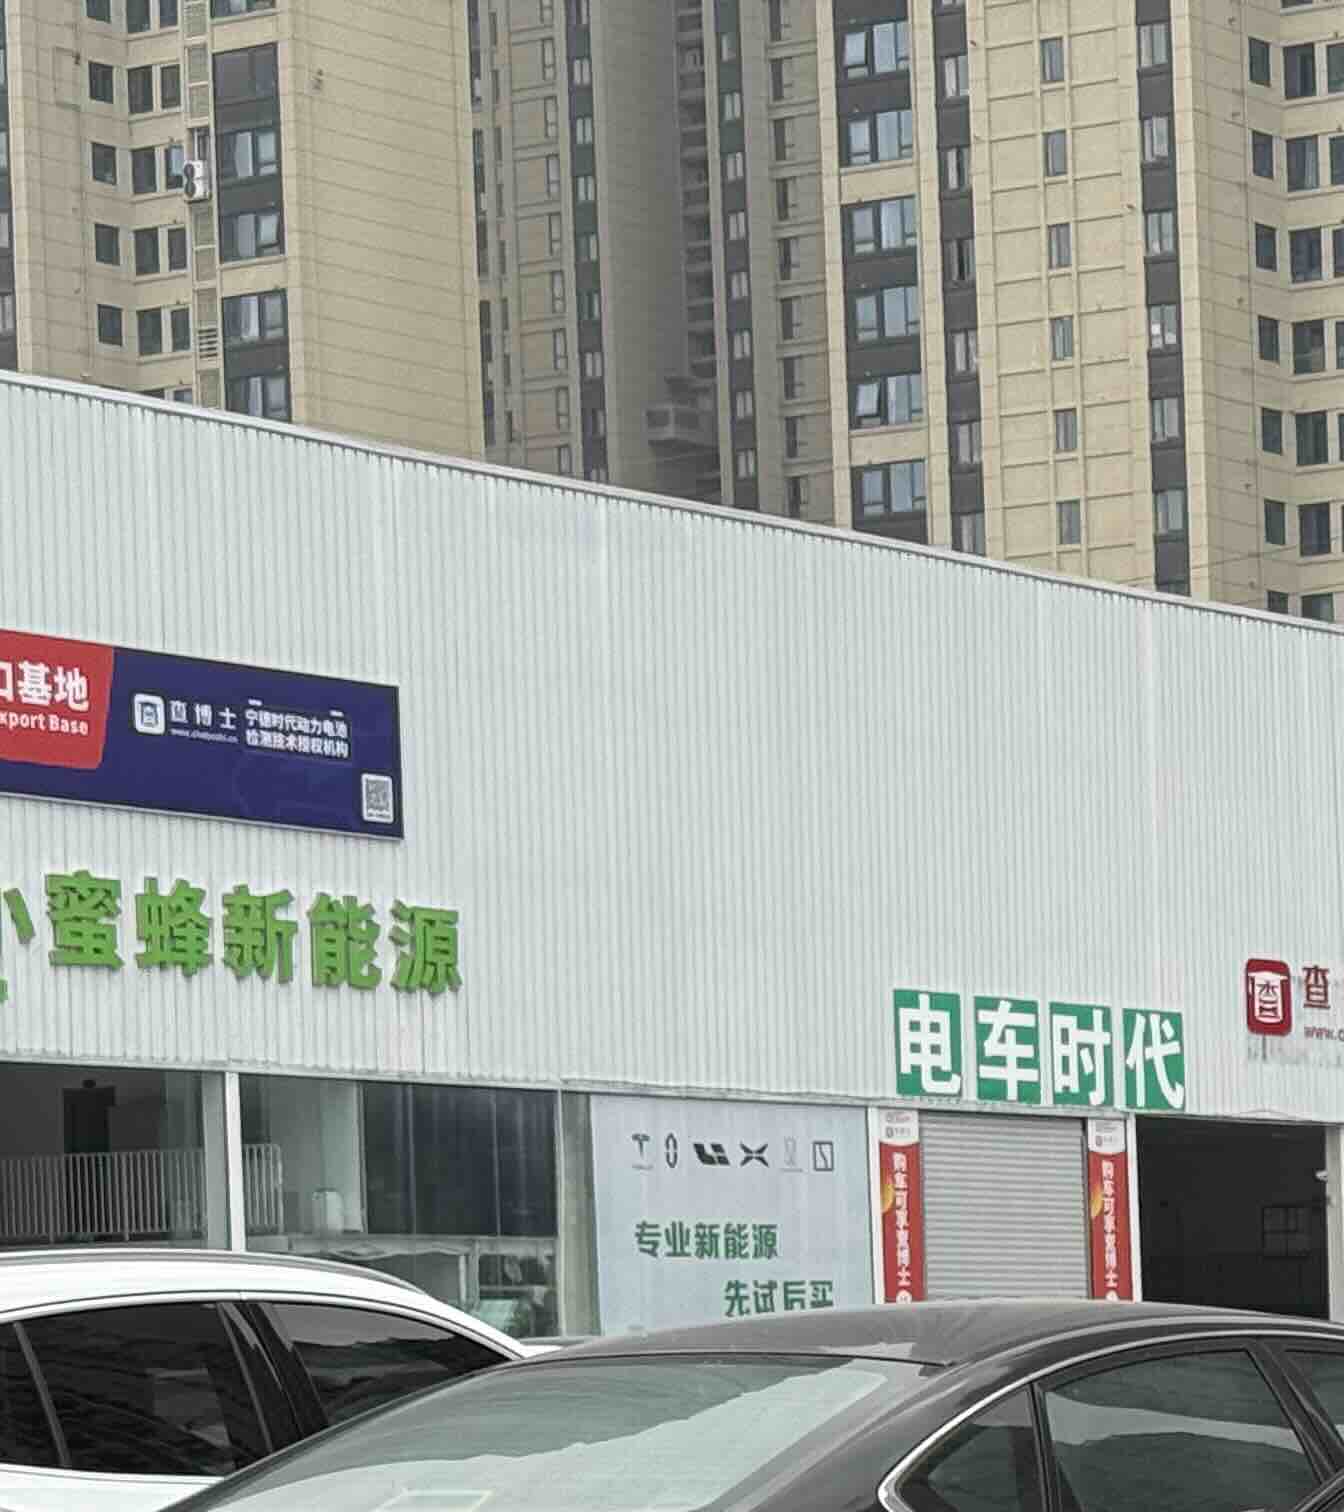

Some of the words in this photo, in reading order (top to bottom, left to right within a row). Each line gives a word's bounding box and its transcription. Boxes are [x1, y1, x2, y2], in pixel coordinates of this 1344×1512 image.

[0, 660, 89, 712] 口基地
[48, 713, 89, 736] Base
[169, 700, 237, 730] 查博士
[898, 993, 1186, 1108] 电车时代
[634, 1220, 779, 1260] 专业新能源
[724, 1279, 834, 1318] 先试后买
